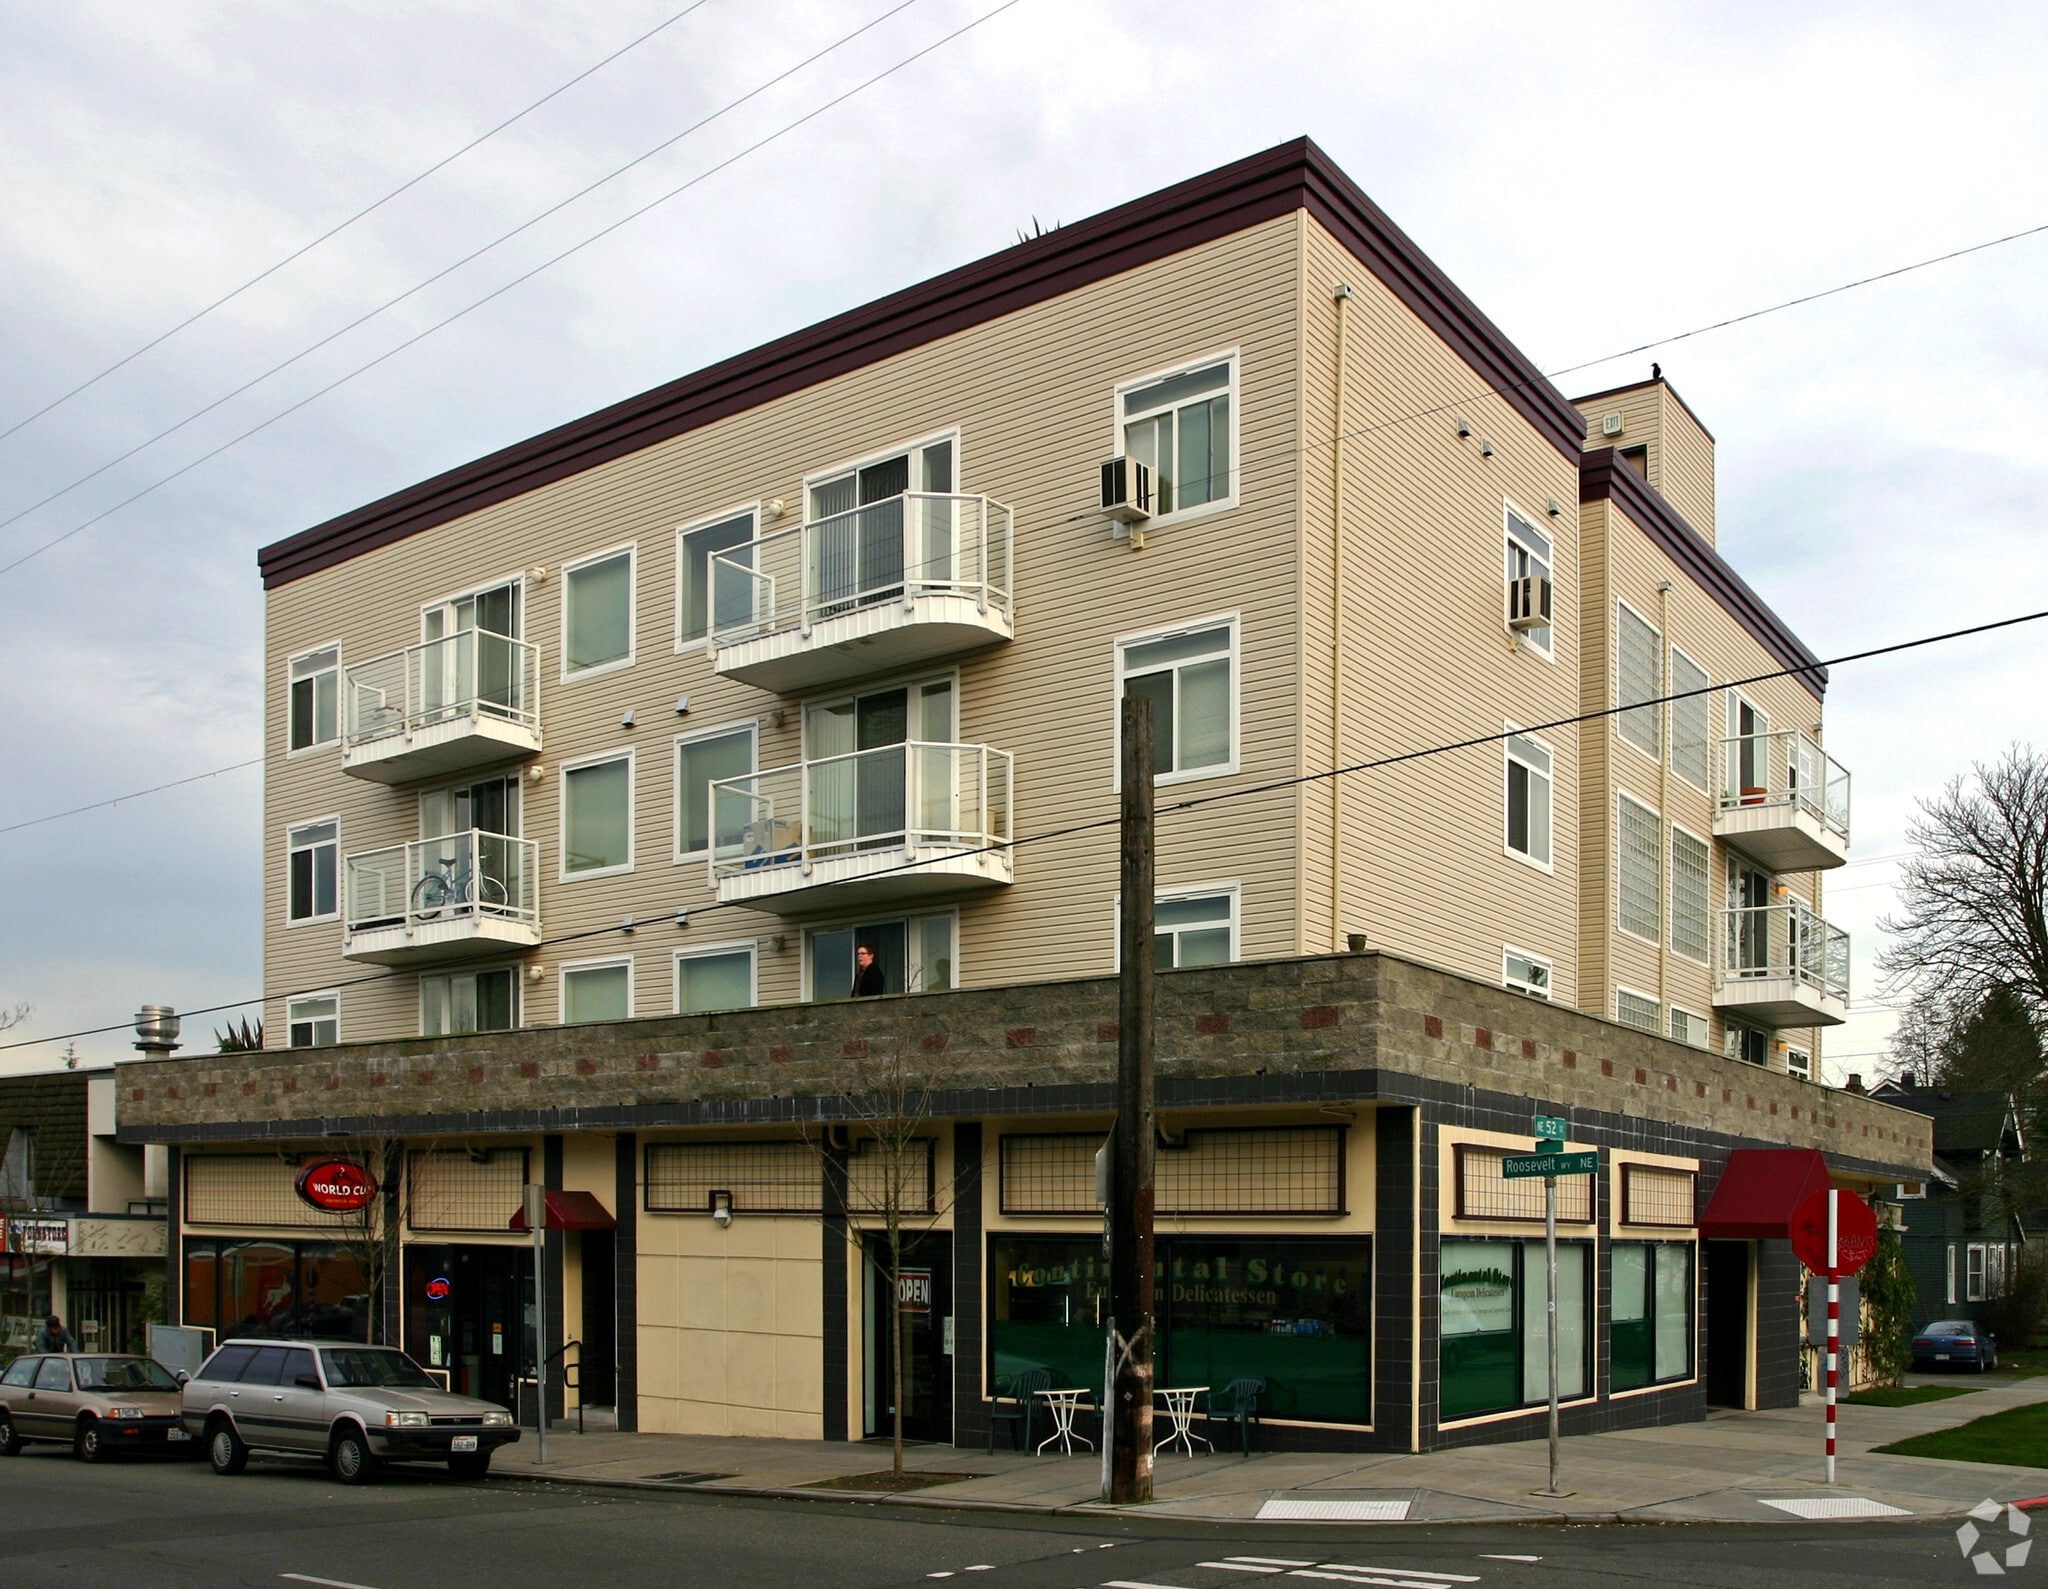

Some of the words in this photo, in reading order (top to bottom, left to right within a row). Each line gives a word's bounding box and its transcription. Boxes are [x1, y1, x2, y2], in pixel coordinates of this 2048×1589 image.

[1536, 1121, 1544, 1132] NE
[1545, 1120, 1557, 1135] 52
[1506, 1157, 1555, 1173] Roosevelt
[1580, 1157, 1593, 1168] NE
[312, 1182, 351, 1196] WORLD
[1248, 1257, 1348, 1294] Store
[899, 1279, 929, 1304] OPEN
[1171, 1283, 1277, 1305] Delicatessen
